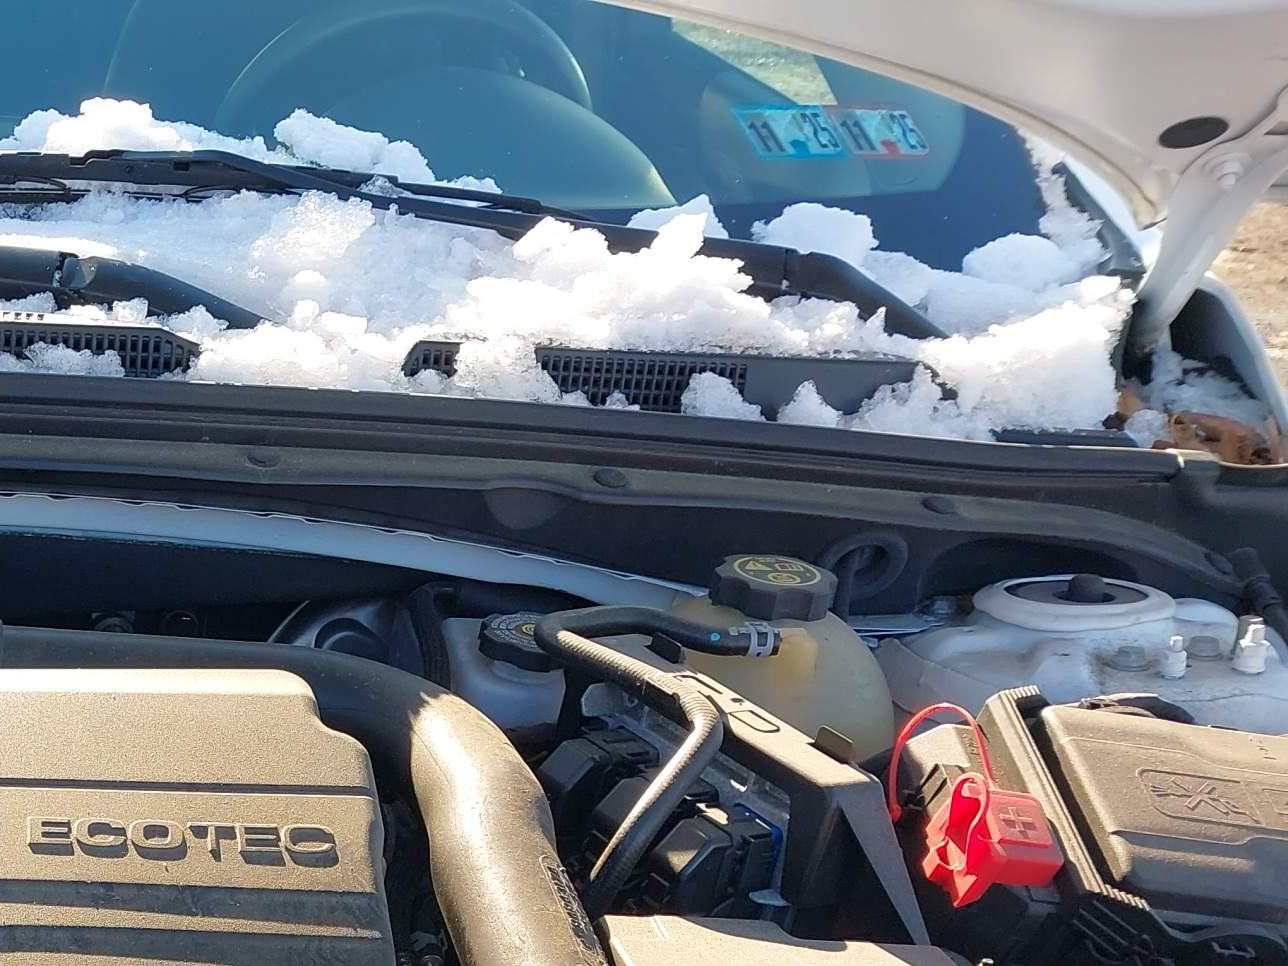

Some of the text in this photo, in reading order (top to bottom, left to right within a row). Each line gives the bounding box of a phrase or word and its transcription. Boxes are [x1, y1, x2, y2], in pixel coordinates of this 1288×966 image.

[748, 112, 841, 153] 11 25
[840, 112, 929, 152] 11 25
[27, 816, 339, 862] ECOTEC
